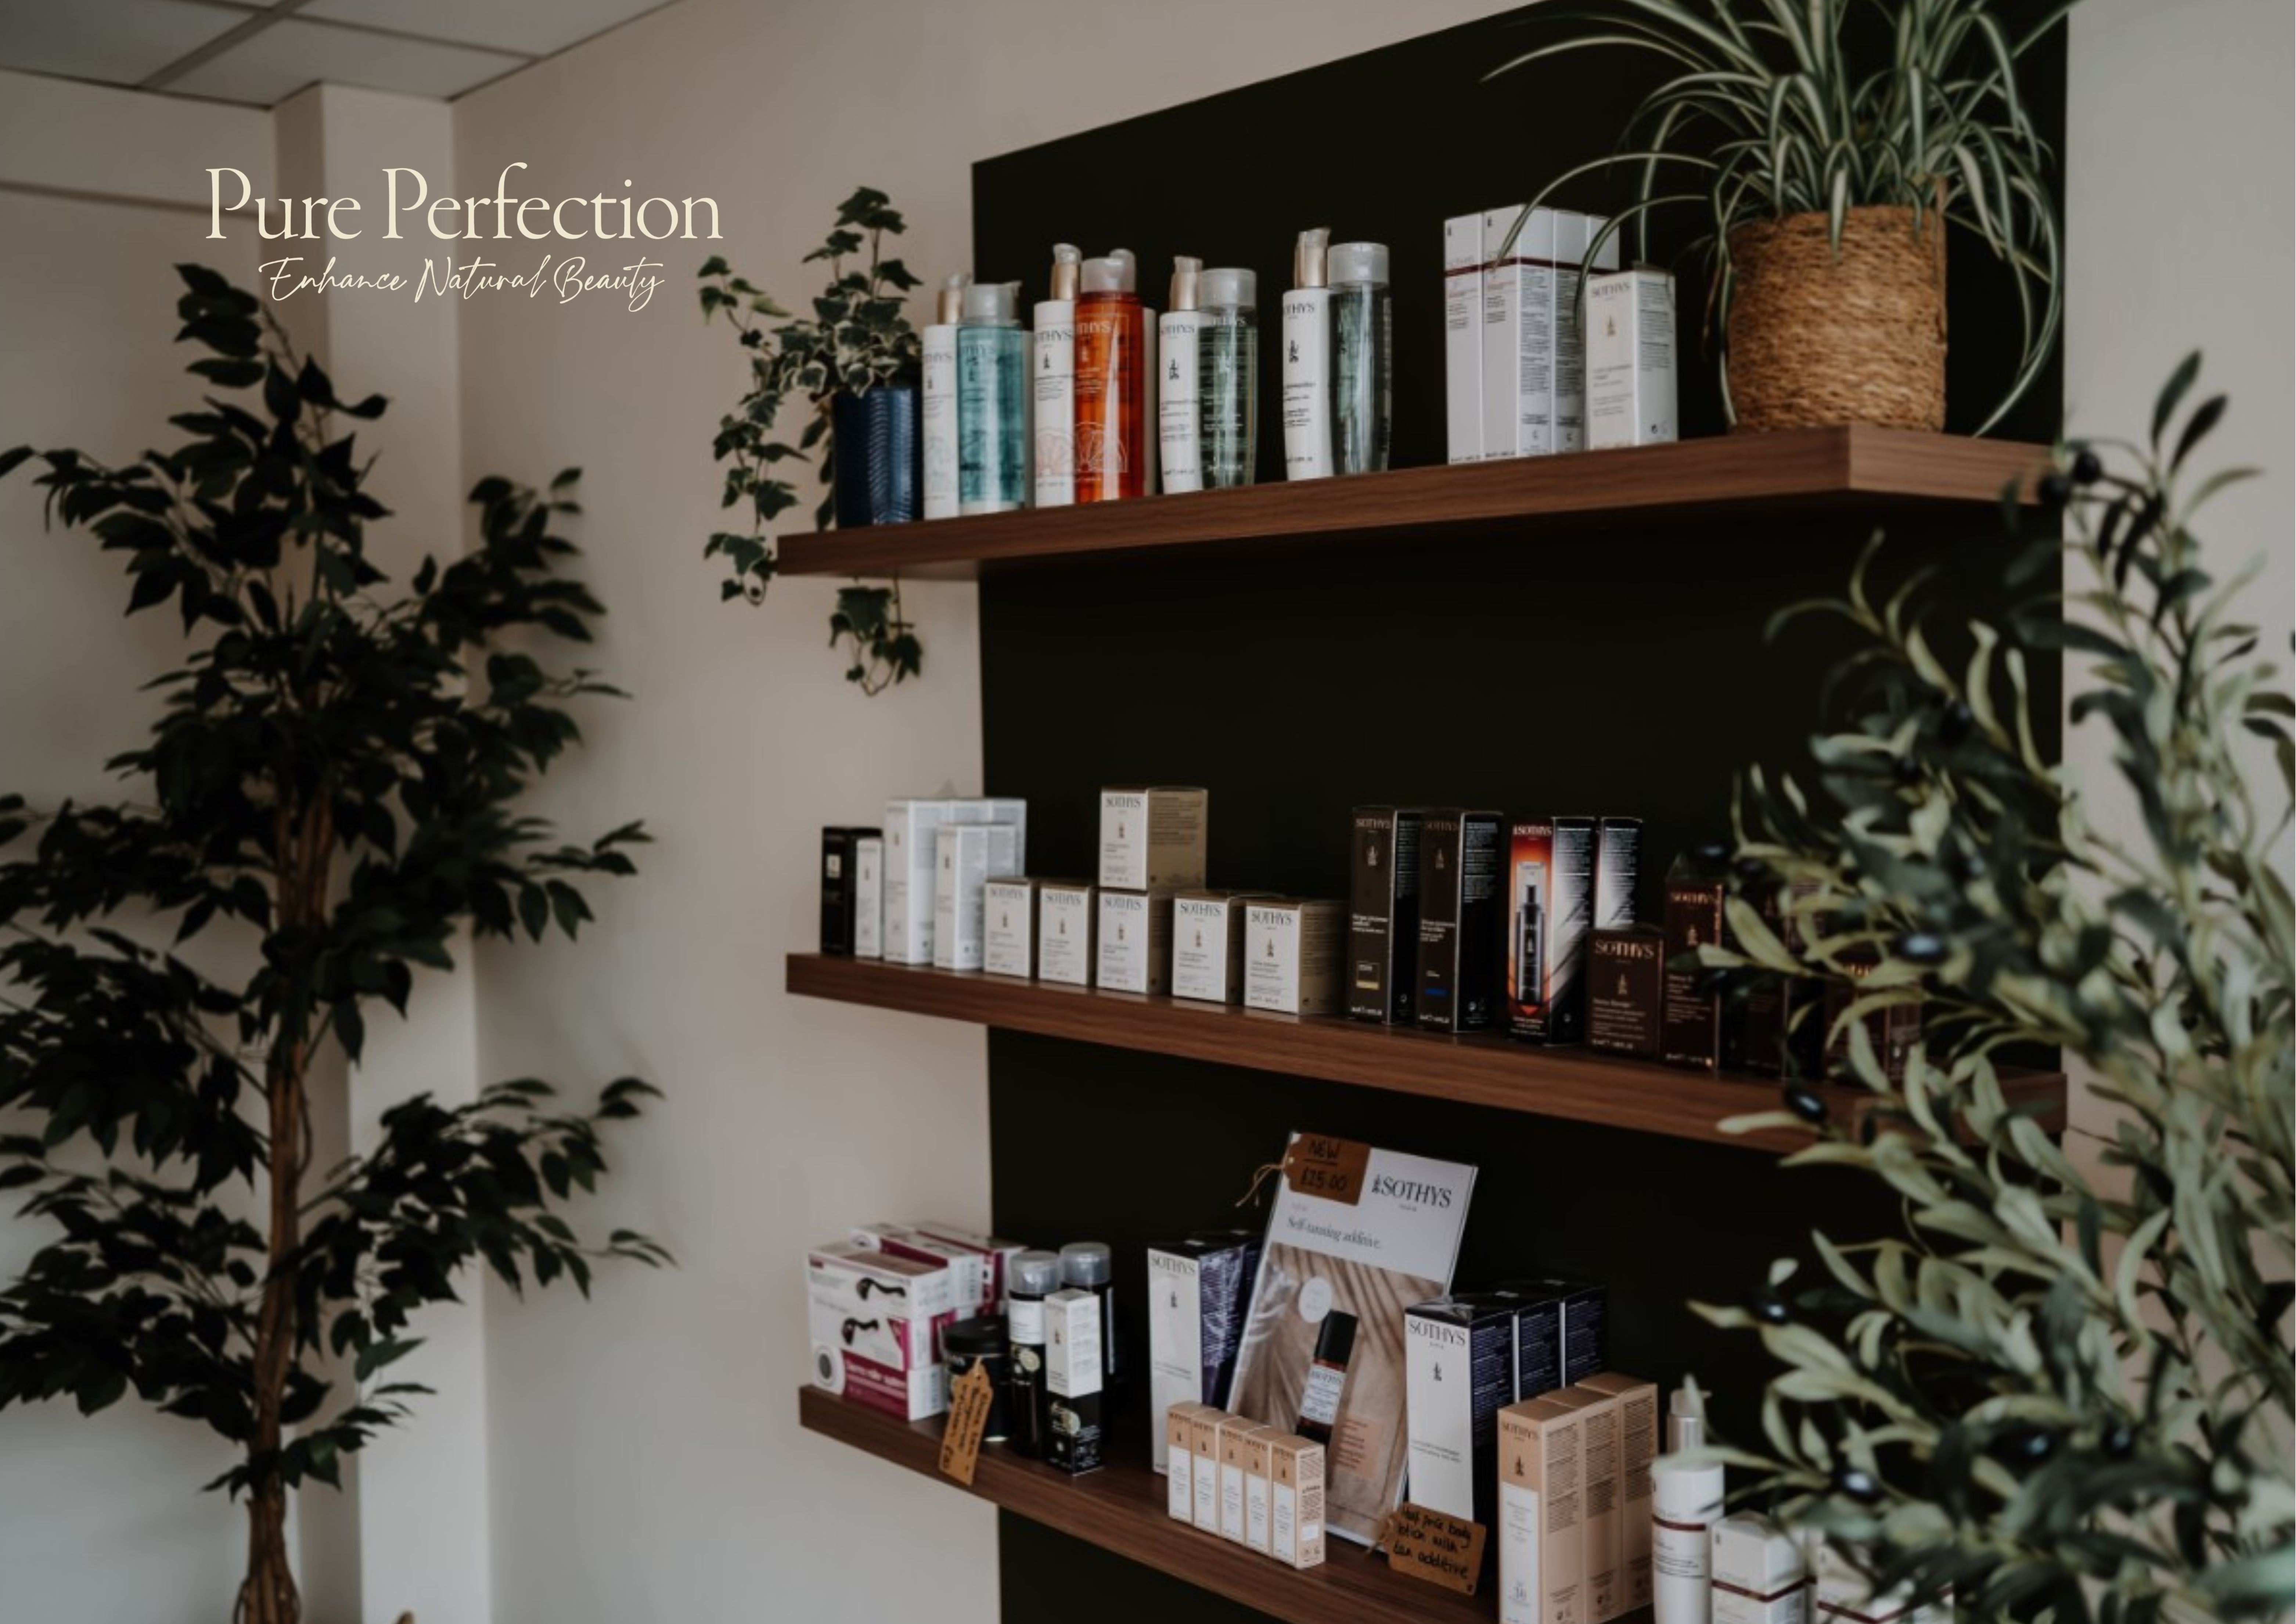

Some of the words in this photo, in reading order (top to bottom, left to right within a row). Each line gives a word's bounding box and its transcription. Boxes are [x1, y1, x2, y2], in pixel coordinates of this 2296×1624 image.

[1251, 910, 1292, 926] SOTHYS
[1595, 940, 1654, 958] SOTHYS
[1381, 1175, 1452, 1208] SOTHYS
[1151, 1257, 1195, 1274] SOTHYS
[1408, 1319, 1466, 1347] SOTHYS
